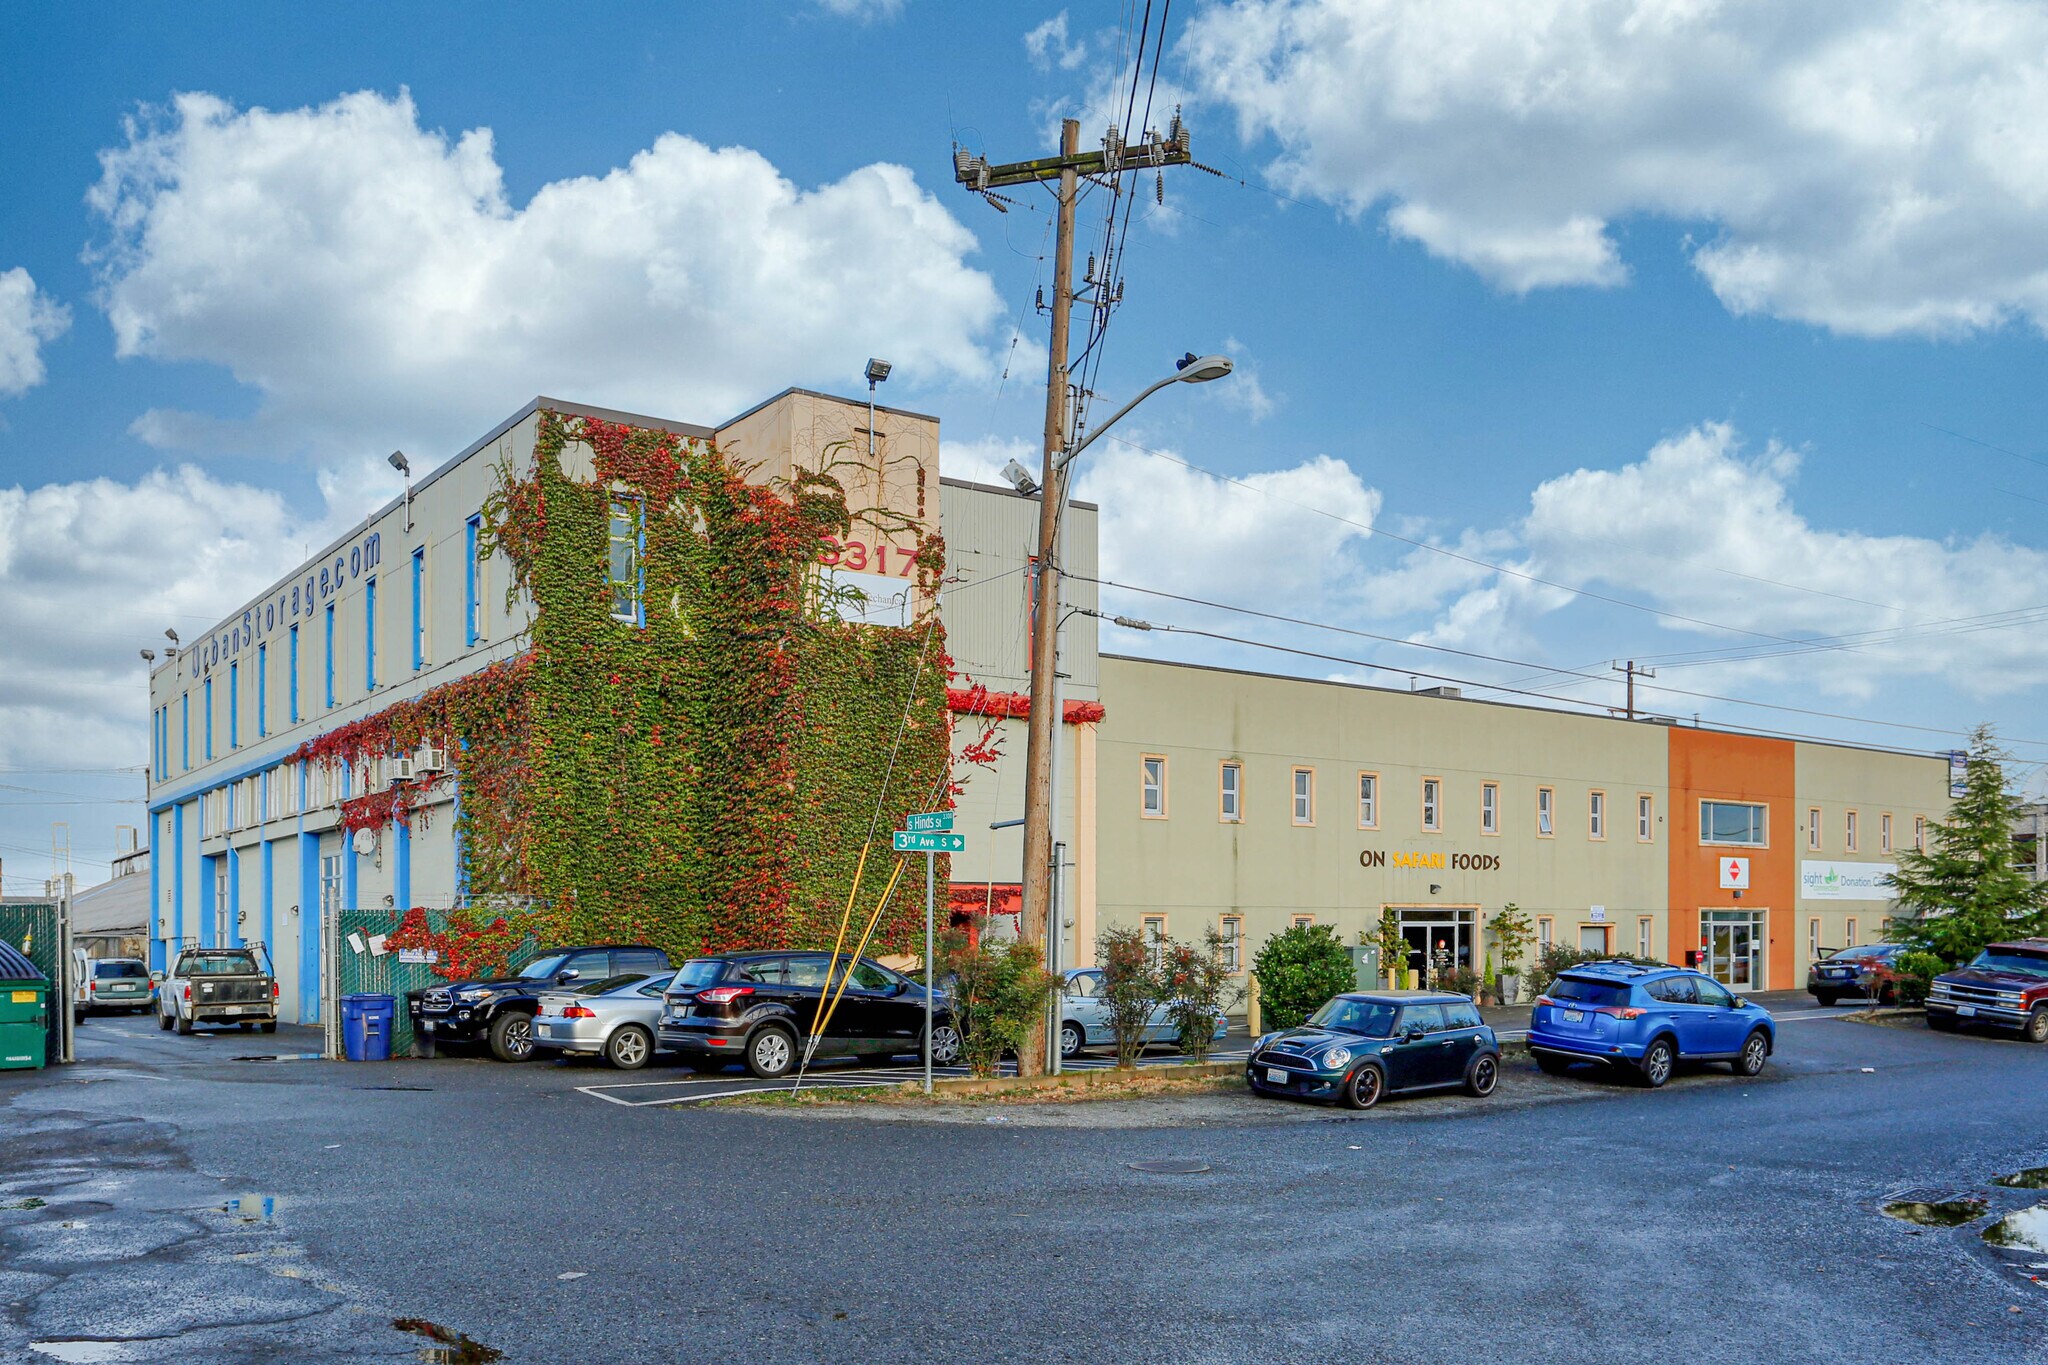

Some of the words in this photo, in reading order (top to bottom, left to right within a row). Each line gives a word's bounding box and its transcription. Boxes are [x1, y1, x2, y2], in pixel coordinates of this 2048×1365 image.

[818, 535, 919, 577] 3317
[192, 532, 381, 678] UrbanStorage.com
[914, 815, 935, 829] Hinds
[935, 818, 942, 828] St
[898, 833, 916, 848] 3rd
[919, 837, 935, 847] Ave
[941, 837, 947, 847] S
[1359, 850, 1385, 867] ON
[1392, 850, 1446, 869] SAFARI
[1451, 853, 1500, 871] FOODS
[1803, 872, 1823, 887] sight
